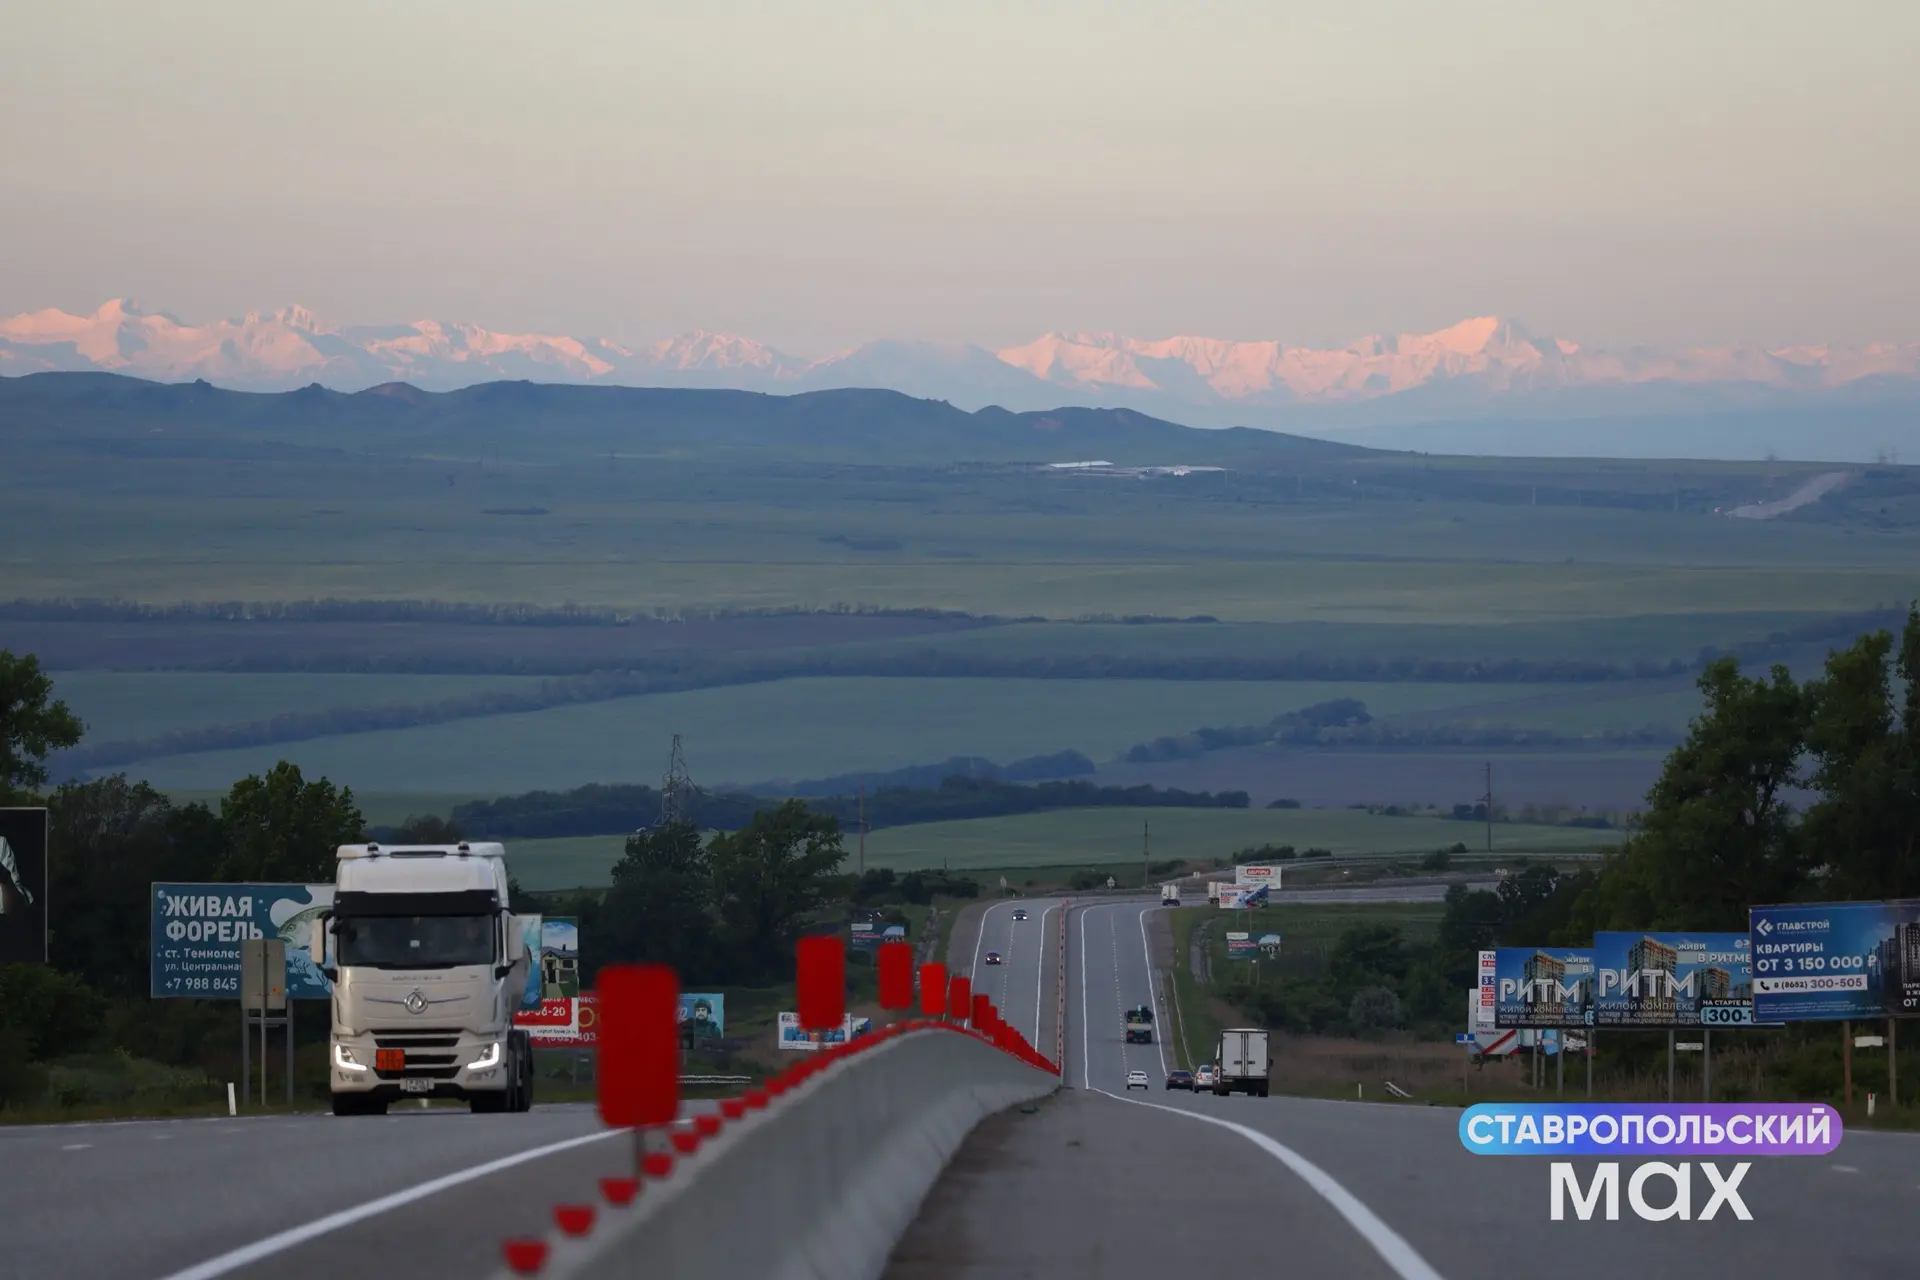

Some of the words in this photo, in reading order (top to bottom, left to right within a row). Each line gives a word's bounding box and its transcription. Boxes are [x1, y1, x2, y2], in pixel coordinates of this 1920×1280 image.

[165, 896, 252, 917] ЖИВАЯ
[165, 919, 263, 942] ФОРЕЛЬ
[1776, 919, 1830, 931] ГЛАВСТРОЙ
[1677, 943, 1706, 951] ЖИВИ
[1756, 942, 1824, 954] КВАРТИРЫ
[164, 950, 180, 959] ст.
[183, 948, 240, 959] Темнолес
[164, 963, 179, 972] ул.
[1756, 958, 1779, 972] ОТ
[1784, 958, 1794, 971] 3
[1798, 957, 1825, 971] 150
[1829, 955, 1863, 969] 000
[165, 978, 181, 989] +7
[185, 977, 208, 989] 988
[213, 977, 237, 989] 845
[1599, 968, 1694, 998] РИТМ
[1810, 978, 1862, 989] 300-505
[1499, 978, 1580, 1003] РИТМ
[1499, 1004, 1531, 1013] ЖИЛОЙ
[1534, 1005, 1580, 1013] КОМПЛЕКС
[1599, 1001, 1637, 1011] ЖИЛОЙ
[1640, 1002, 1695, 1011] КОМПЛЕКС
[1903, 998, 1918, 1007] ОТ
